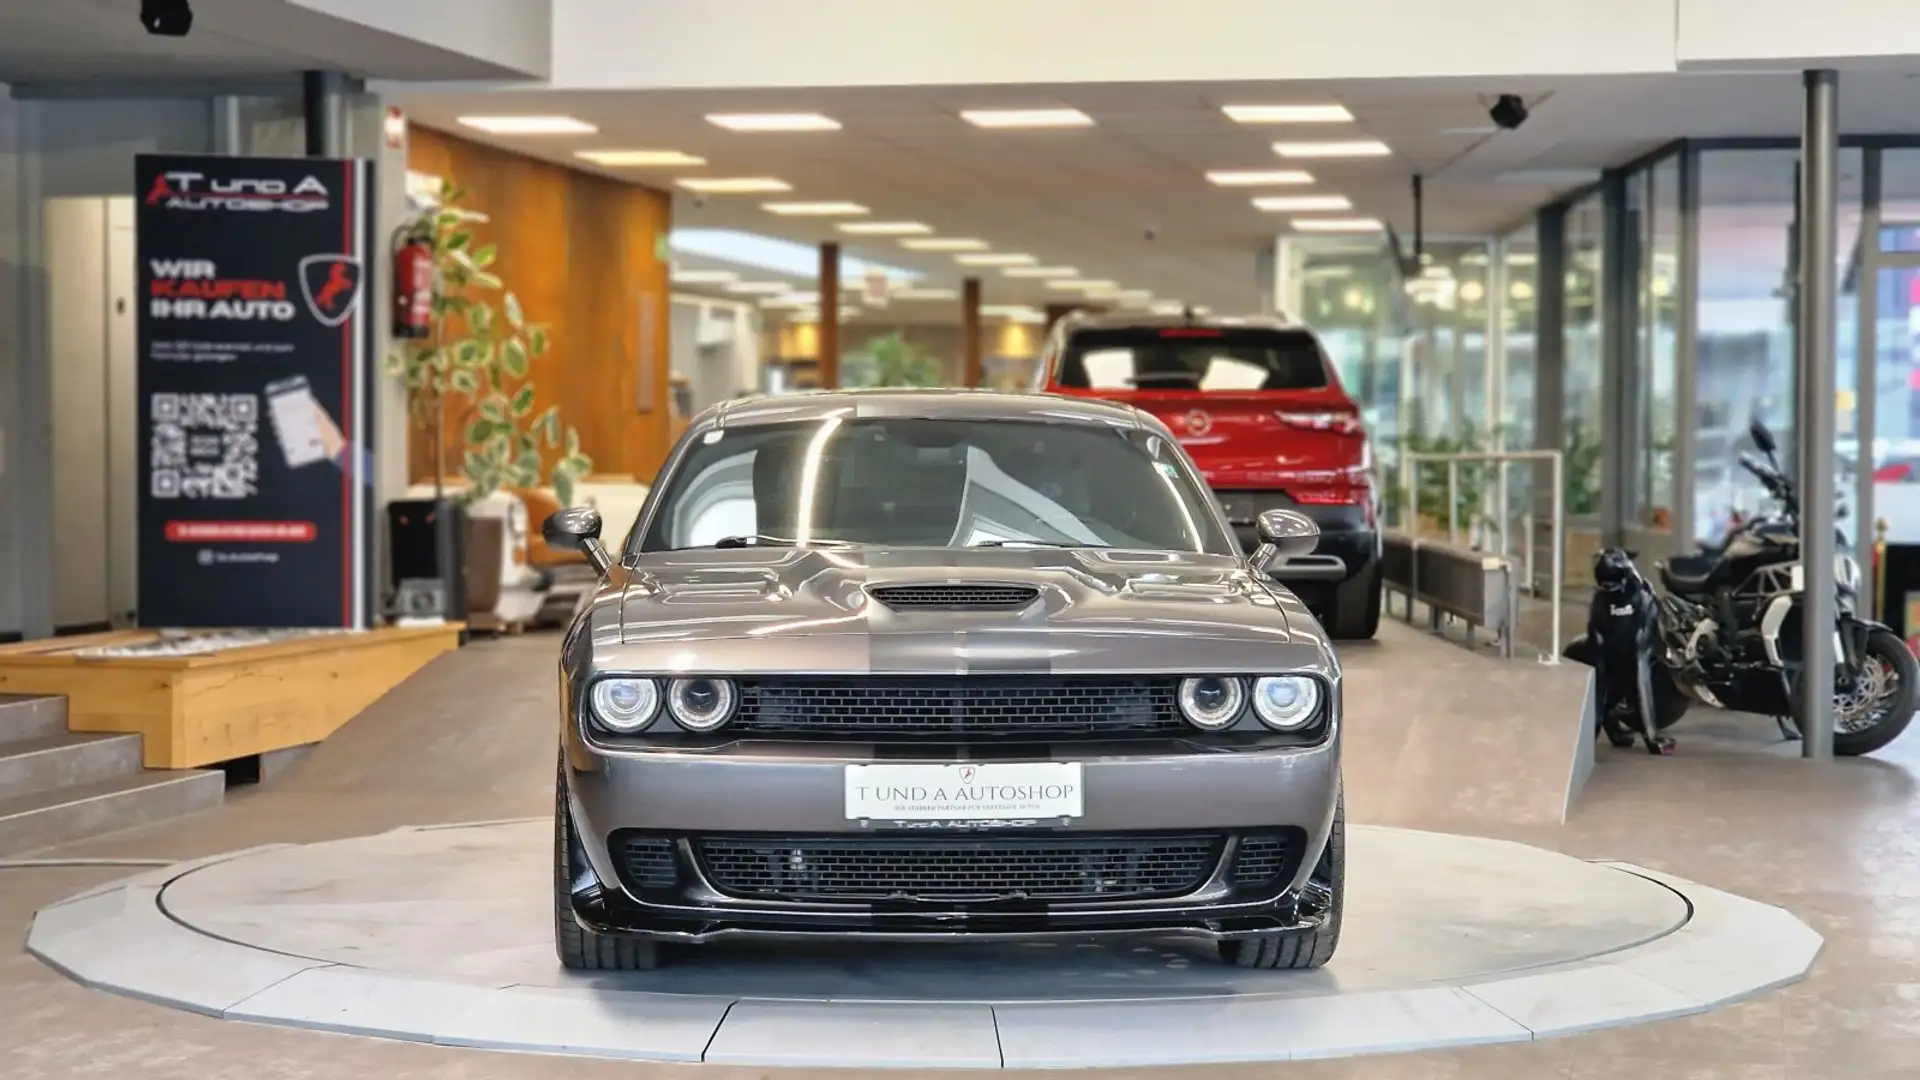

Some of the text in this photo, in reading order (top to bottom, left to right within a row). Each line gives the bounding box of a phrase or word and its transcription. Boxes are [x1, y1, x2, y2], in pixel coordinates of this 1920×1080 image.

[165, 171, 204, 191] T
[292, 174, 329, 196] A
[166, 196, 330, 212] AUTOSHOP
[150, 259, 216, 279] WIR
[151, 279, 286, 301] KAUFEN
[151, 298, 296, 321] IHR AUTO
[855, 785, 1074, 801] T UND A AUTOSHOP
[947, 819, 1038, 829] AUTOSHOP
